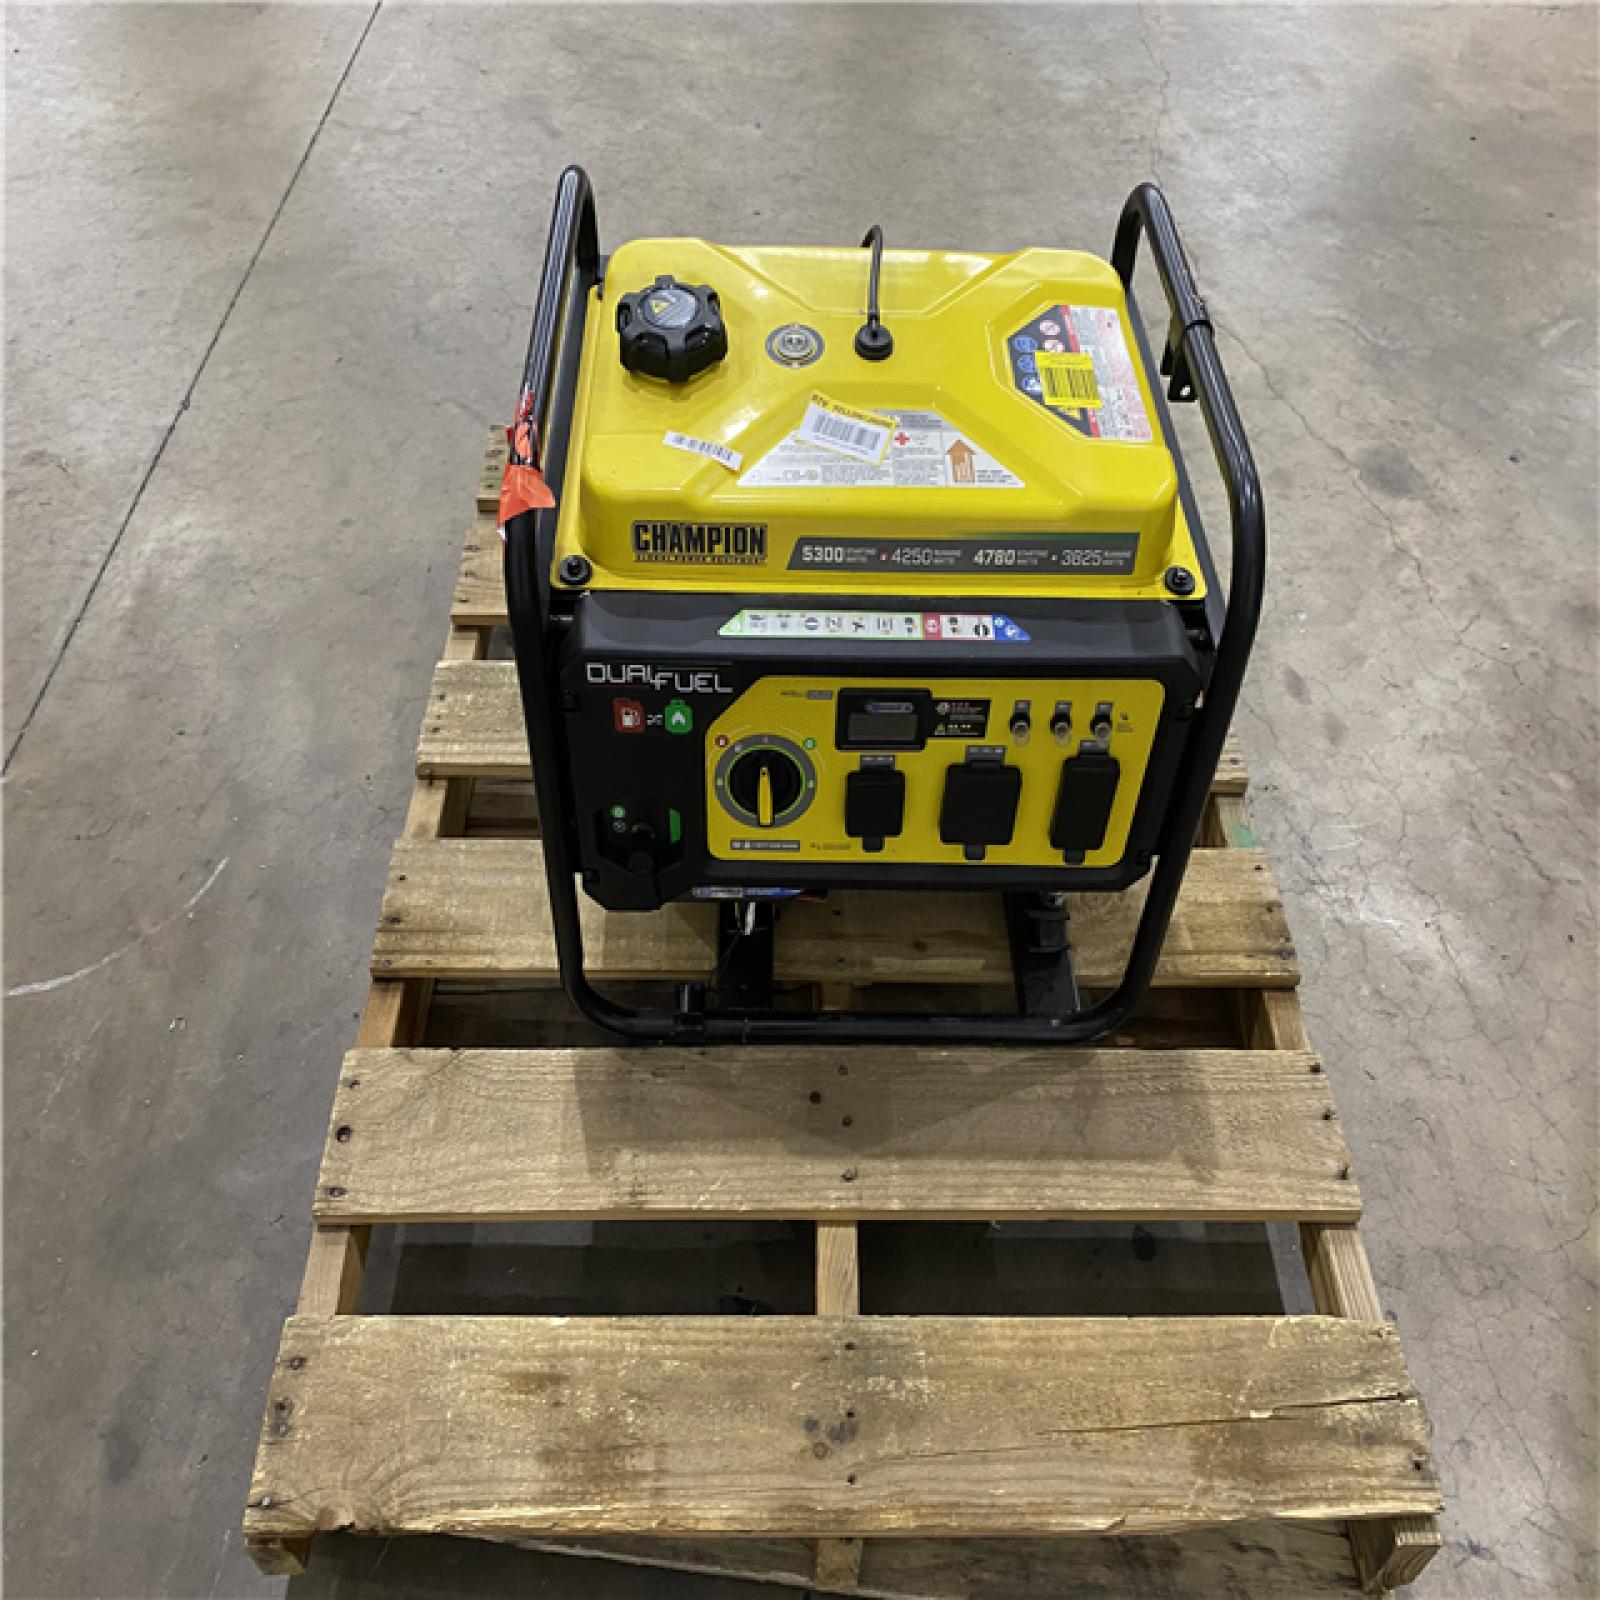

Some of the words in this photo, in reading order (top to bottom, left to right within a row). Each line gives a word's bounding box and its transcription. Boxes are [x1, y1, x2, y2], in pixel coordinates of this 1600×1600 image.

[634, 524, 764, 554] CHAMPION
[801, 545, 844, 563] 5300
[586, 662, 659, 684] DUAL
[654, 672, 733, 693] FUEL
